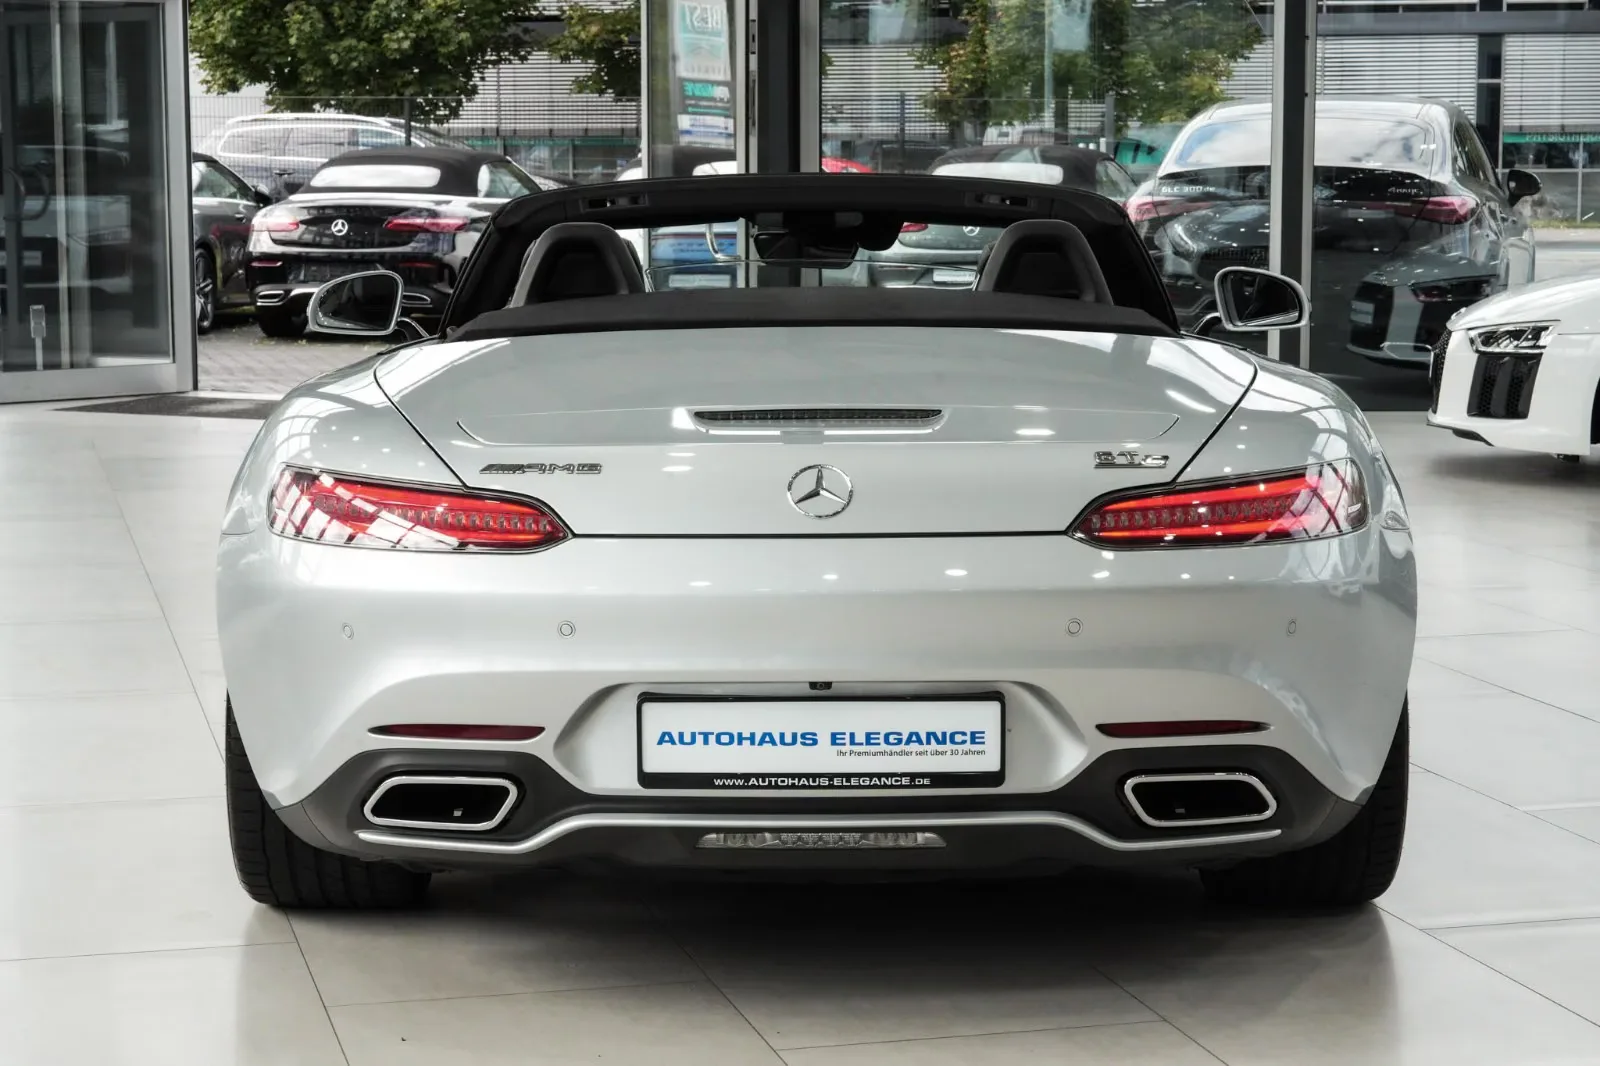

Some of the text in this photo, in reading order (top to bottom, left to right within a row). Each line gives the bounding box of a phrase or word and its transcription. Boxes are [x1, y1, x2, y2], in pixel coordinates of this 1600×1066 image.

[656, 731, 986, 747] AUTOHAUS ELEGANCE
[837, 749, 847, 757] Ihr
[849, 749, 913, 757] Premiumhändler
[914, 749, 928, 757] seit
[960, 748, 986, 756] Jahren
[713, 777, 931, 786] www.AUTOHAUS-ELEGANCE.DE
